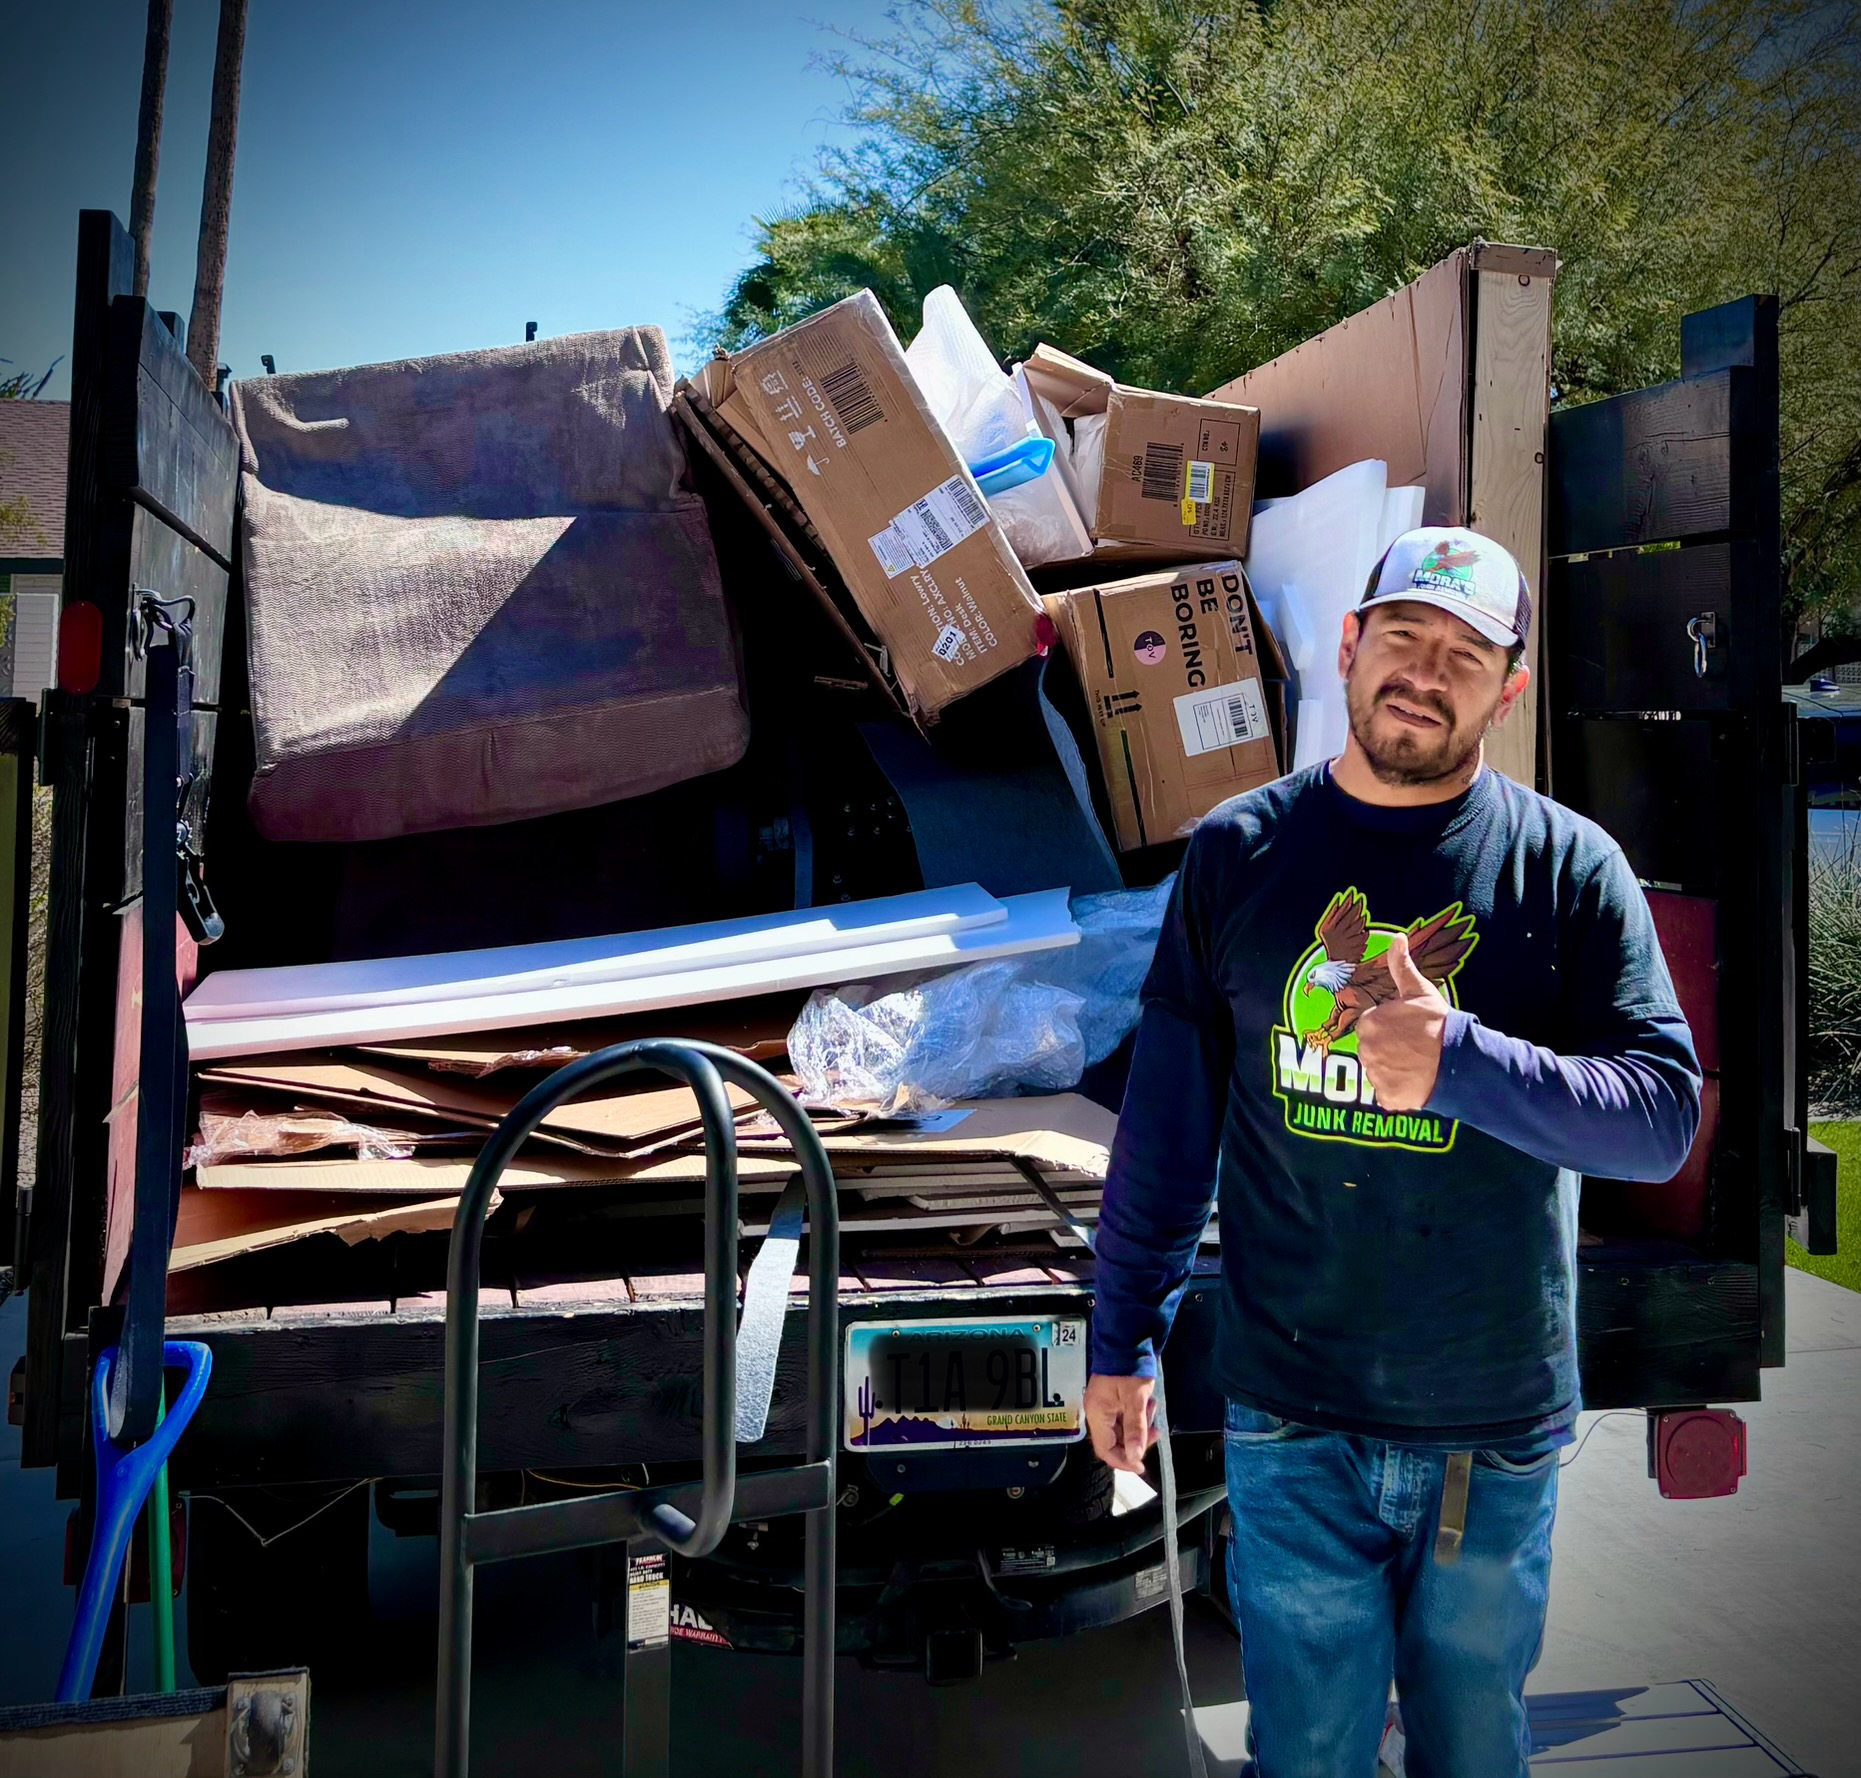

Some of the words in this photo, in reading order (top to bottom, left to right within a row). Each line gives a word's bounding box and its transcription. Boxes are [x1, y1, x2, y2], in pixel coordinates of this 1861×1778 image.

[799, 375, 825, 411] CODE:
[819, 410, 847, 448] BATCH
[1132, 455, 1144, 482] AC469
[909, 573, 930, 605] Lowry
[919, 567, 946, 606] AXCLRY
[953, 576, 978, 612] Walnut
[1196, 578, 1220, 614] BE
[941, 605, 956, 625] NO:
[953, 602, 971, 627] Desk
[972, 610, 998, 647] COLOR:
[1222, 574, 1252, 656] DON'T
[967, 626, 987, 653] ITEM:
[1144, 636, 1155, 659] TOV
[1170, 584, 1206, 688] BORING
[1294, 1103, 1348, 1132] JUNK
[1352, 1110, 1444, 1143] REMOVAL
[910, 1328, 1025, 1344] ARIZONA
[1062, 1328, 1076, 1342] 24
[987, 1415, 1012, 1426] GRAND
[1016, 1414, 1044, 1424] CANYON
[1047, 1412, 1066, 1423] STATE
